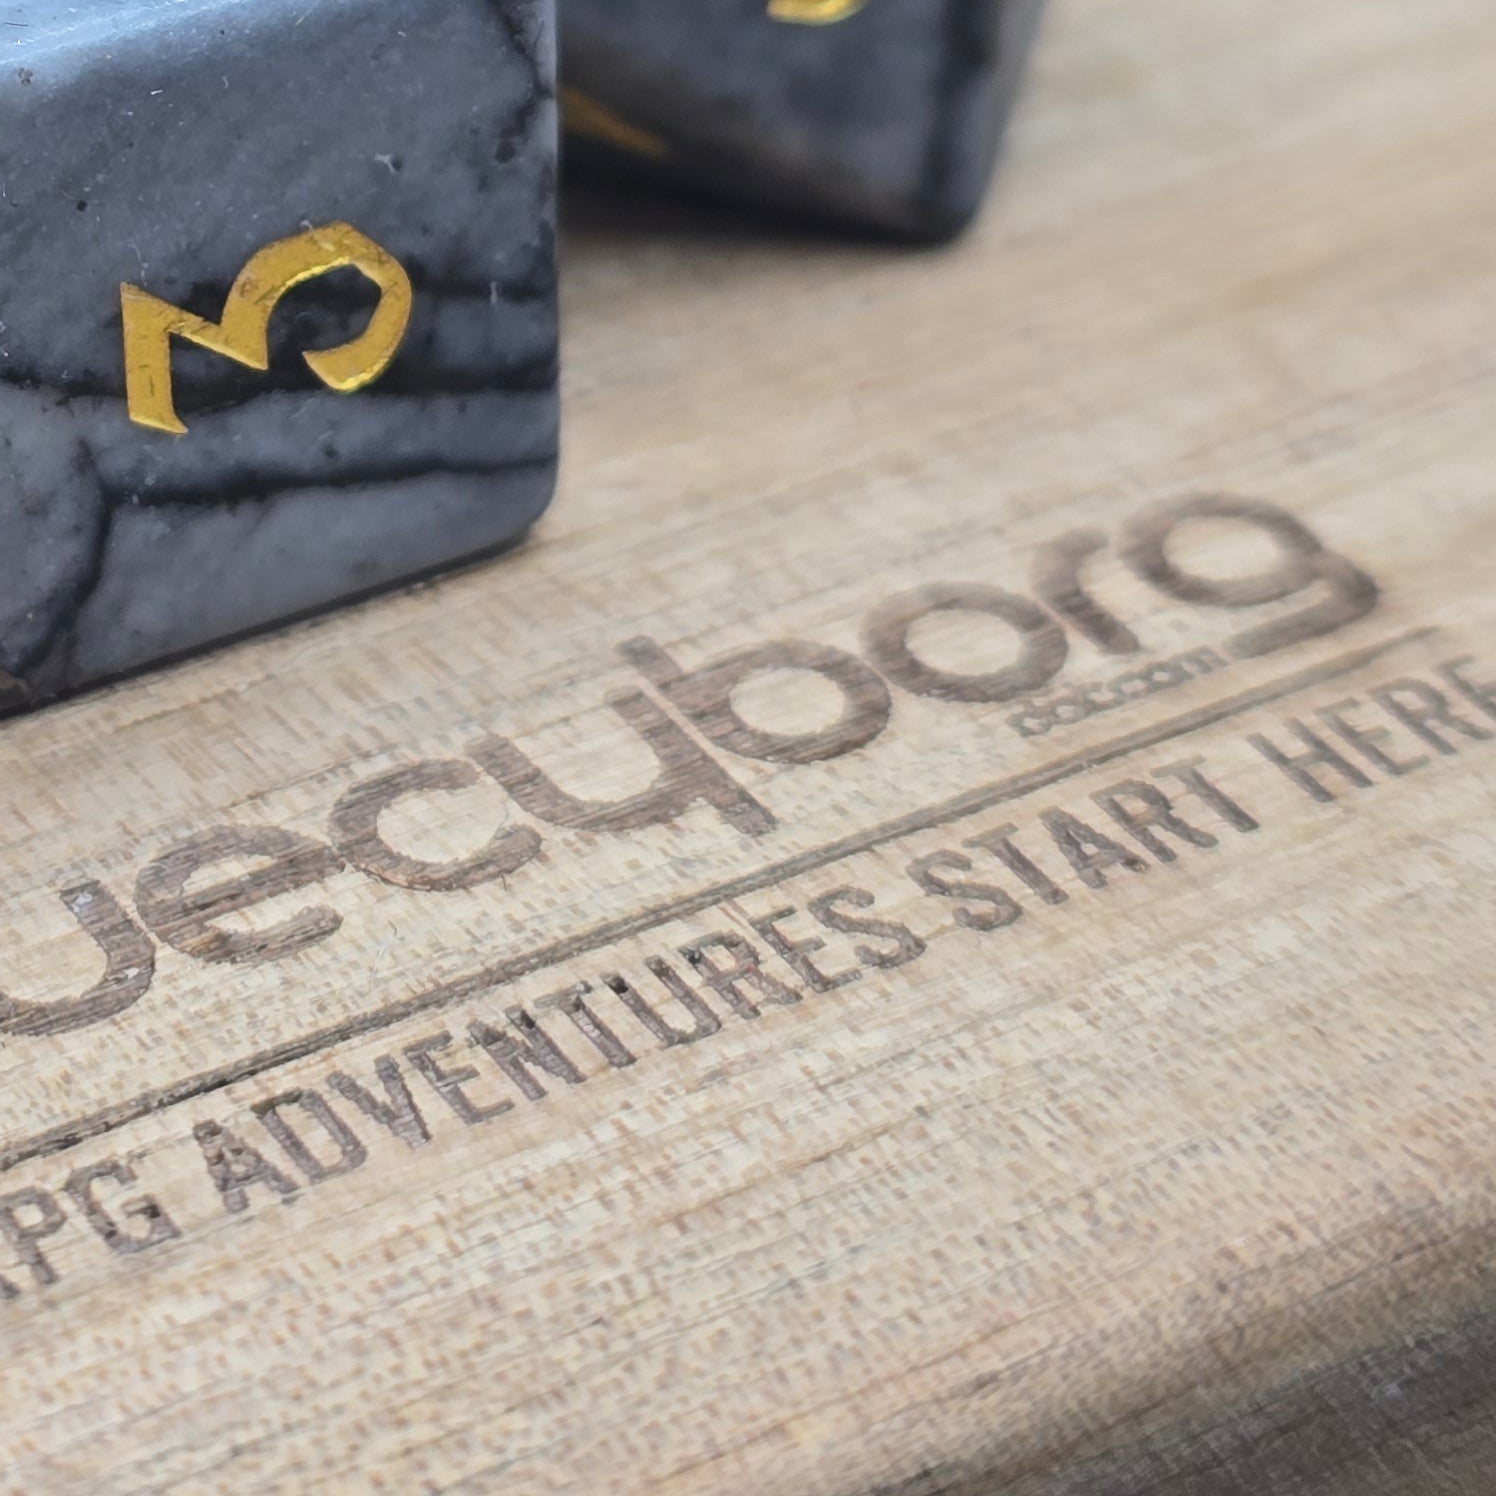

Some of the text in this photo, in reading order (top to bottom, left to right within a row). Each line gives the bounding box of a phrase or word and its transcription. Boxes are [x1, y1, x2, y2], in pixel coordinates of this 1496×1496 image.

[120, 218, 413, 435] 3
[192, 883, 927, 1215] ADVENTURES
[906, 756, 1261, 932] START
